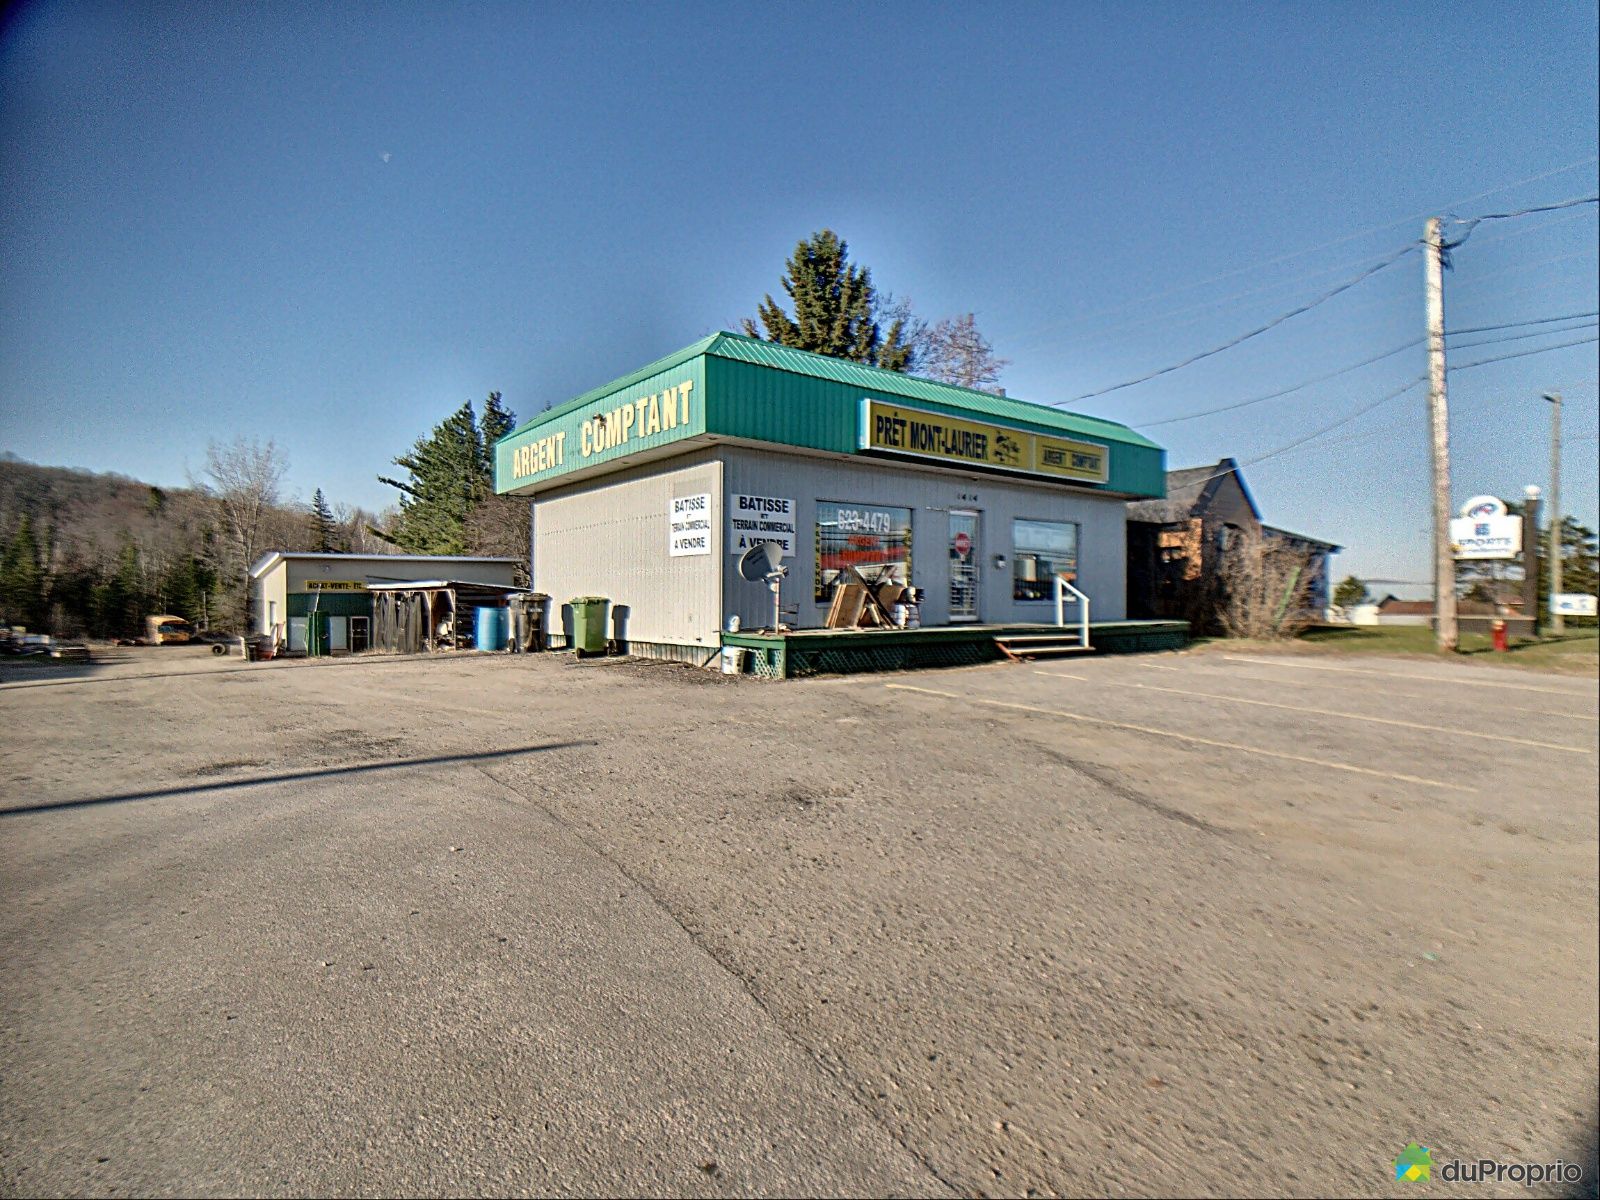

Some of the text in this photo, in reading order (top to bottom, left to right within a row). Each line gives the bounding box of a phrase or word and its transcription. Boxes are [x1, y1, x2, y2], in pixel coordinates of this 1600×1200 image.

[512, 379, 693, 479] ARGENT COMPTANT
[910, 421, 989, 460] MONT-LAURIER
[674, 496, 705, 513] BATISSE
[739, 496, 789, 513] BATISSE
[732, 518, 795, 533] TERRAIN COMMERCIAL
[680, 537, 705, 549] VENDRE
